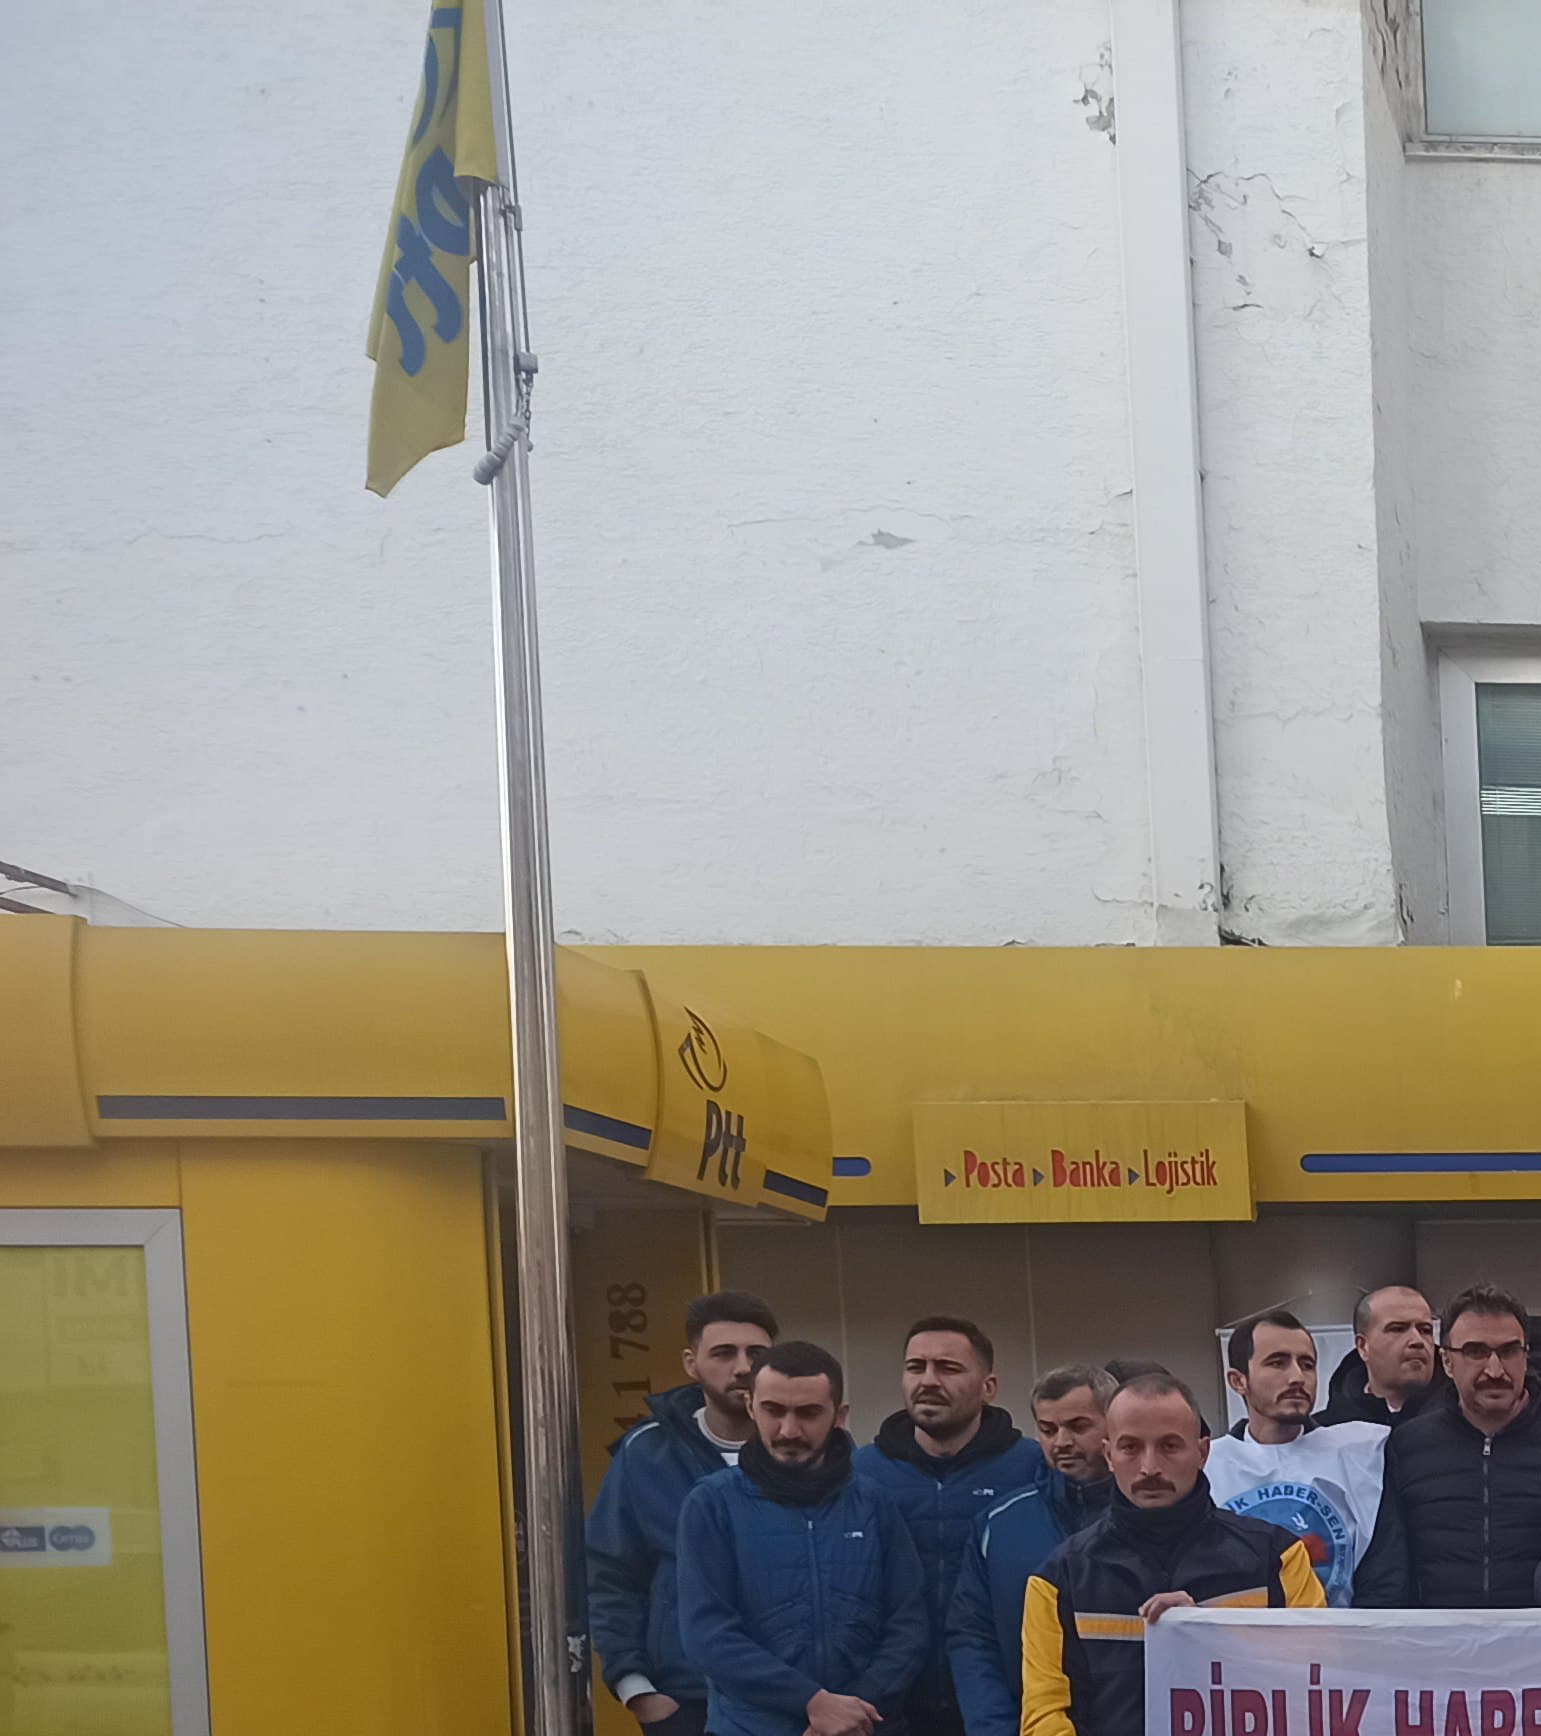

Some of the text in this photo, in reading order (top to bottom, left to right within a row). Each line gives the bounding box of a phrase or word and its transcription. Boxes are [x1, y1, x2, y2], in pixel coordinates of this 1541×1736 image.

[697, 1098, 747, 1191] Ptt
[963, 1148, 1218, 1195] Posta Banka Lojistik
